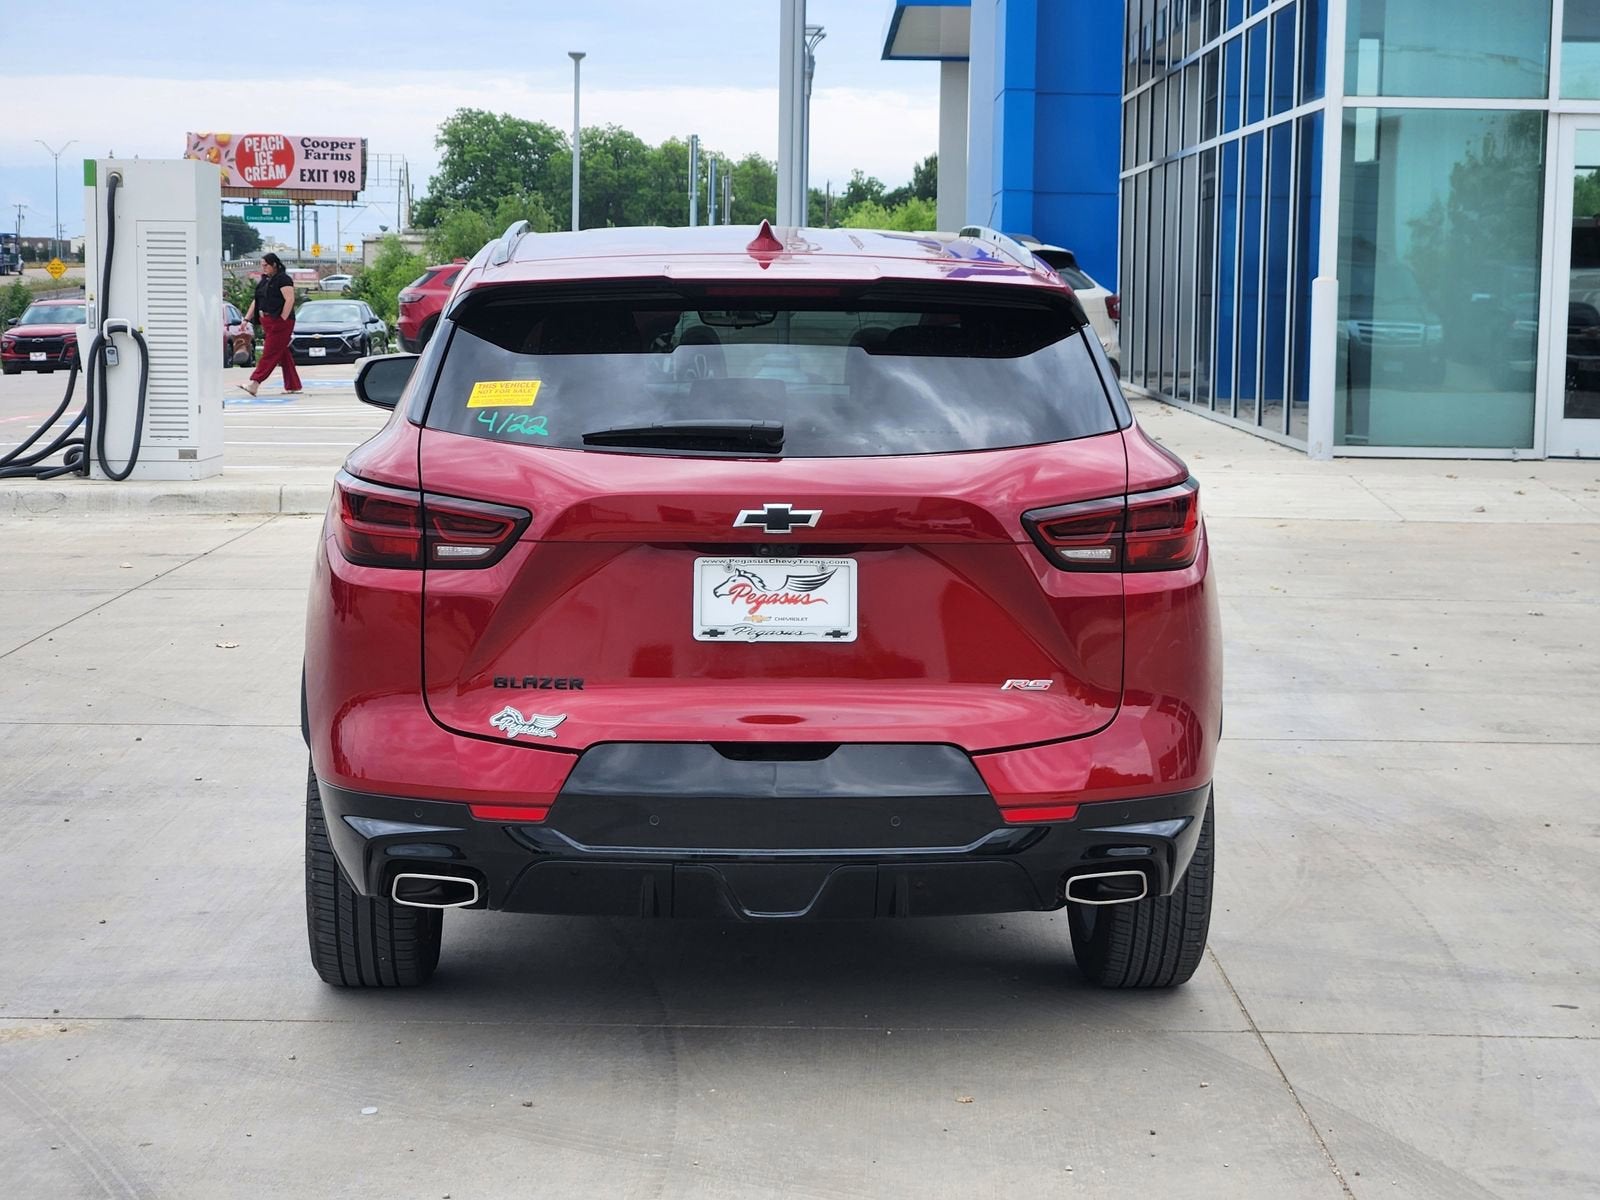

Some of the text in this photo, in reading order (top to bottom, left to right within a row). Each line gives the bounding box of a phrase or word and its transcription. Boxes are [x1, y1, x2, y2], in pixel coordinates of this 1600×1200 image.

[245, 137, 284, 152] PEACH
[300, 137, 356, 151] Cooper
[254, 151, 274, 166] ICE
[304, 149, 352, 161] Farms
[245, 165, 286, 181] CREAM
[300, 168, 356, 184] EXIT 198
[478, 411, 548, 436] 4/22
[728, 583, 828, 614] Pegasus
[732, 626, 818, 640] Pegasus
[494, 677, 584, 690] BLAZER
[1001, 680, 1053, 690] RS
[499, 716, 558, 738] Pegasus
